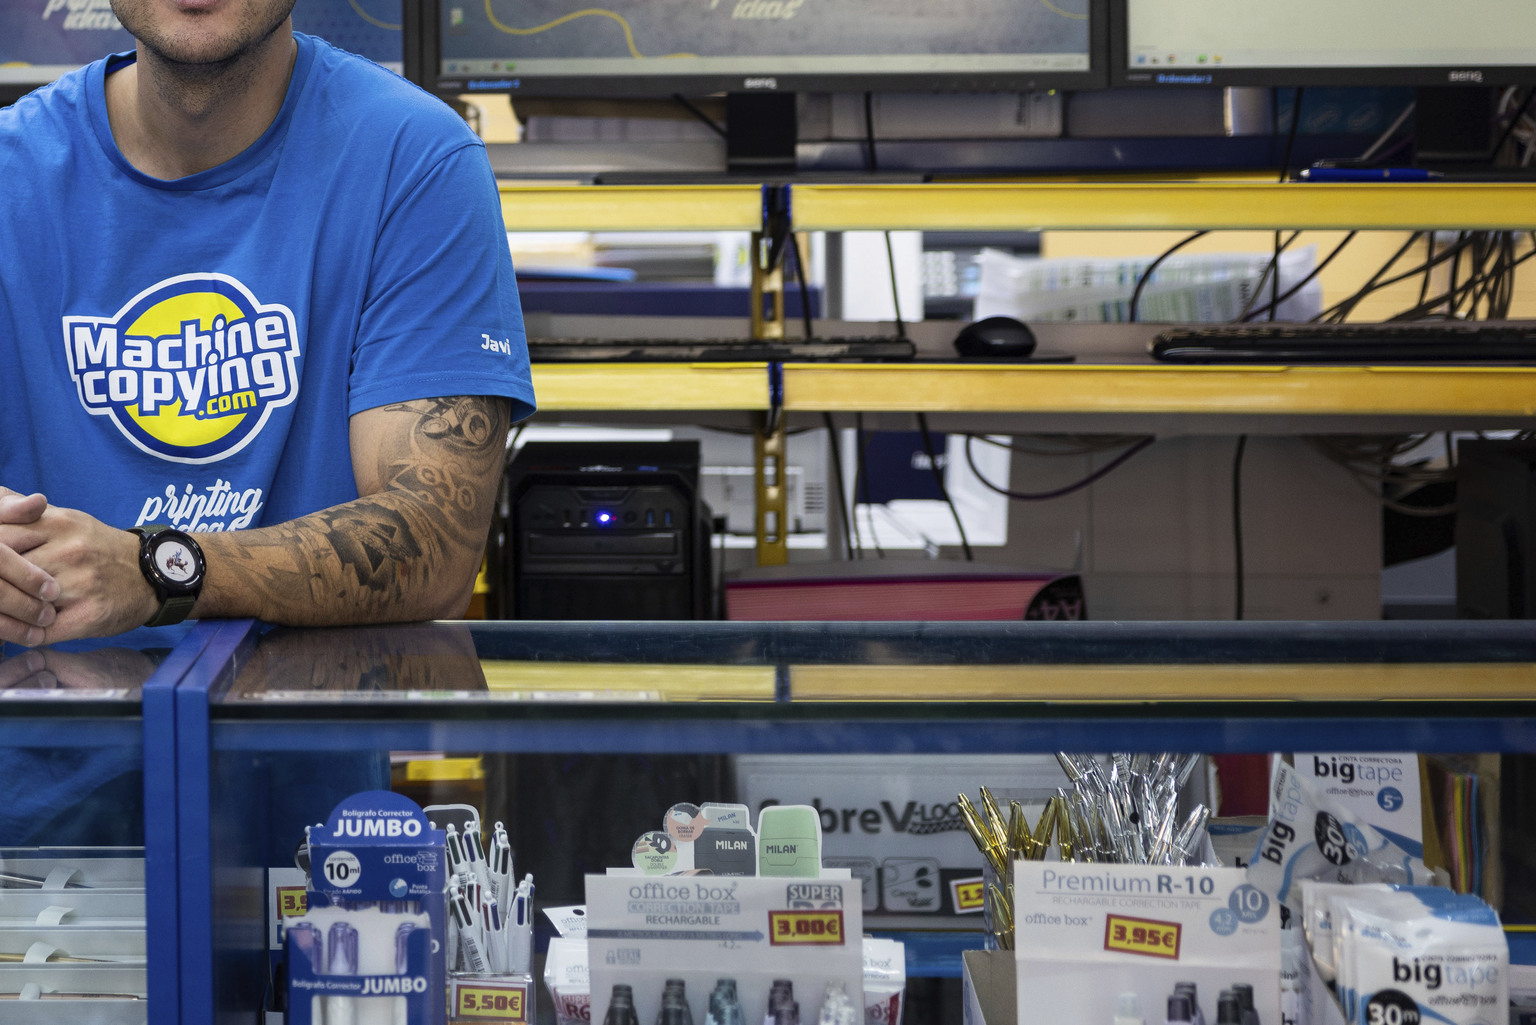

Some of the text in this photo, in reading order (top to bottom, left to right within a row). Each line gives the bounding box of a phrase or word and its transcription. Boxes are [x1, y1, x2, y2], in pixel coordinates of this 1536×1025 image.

[74, 310, 286, 370] Machine
[481, 334, 512, 357] Javi
[83, 349, 282, 413] copying
[199, 389, 257, 417] .com
[135, 479, 263, 528] printing
[1314, 756, 1402, 785] big tape
[1280, 775, 1304, 823] tape
[1383, 795, 1394, 809] 5
[342, 809, 376, 817] Bolígrafo
[717, 812, 736, 822] MILAN
[333, 819, 422, 837] JUMBO
[716, 840, 748, 850] MILAN
[766, 844, 796, 854] MILAN
[1262, 821, 1296, 865] big
[384, 854, 417, 864] office
[417, 863, 436, 872] box
[326, 863, 360, 880] 10 ml
[1043, 870, 1214, 895] Premium R-10
[629, 883, 736, 901] office box
[791, 886, 840, 900] SUPER
[1235, 890, 1261, 911] 10
[628, 902, 739, 914] CORRECTION TAPE
[1052, 896, 1200, 909] RECHARGABLE TAPE
[646, 916, 720, 925] RECHARGABLE
[777, 919, 839, 937] 3,00€
[1025, 913, 1088, 926] office box
[1113, 924, 1175, 948] 3,95€
[1393, 956, 1499, 989] big tape
[361, 977, 427, 994] JUMBO
[464, 995, 520, 1012] 5,50€
[1368, 1004, 1419, 1025] 30m
